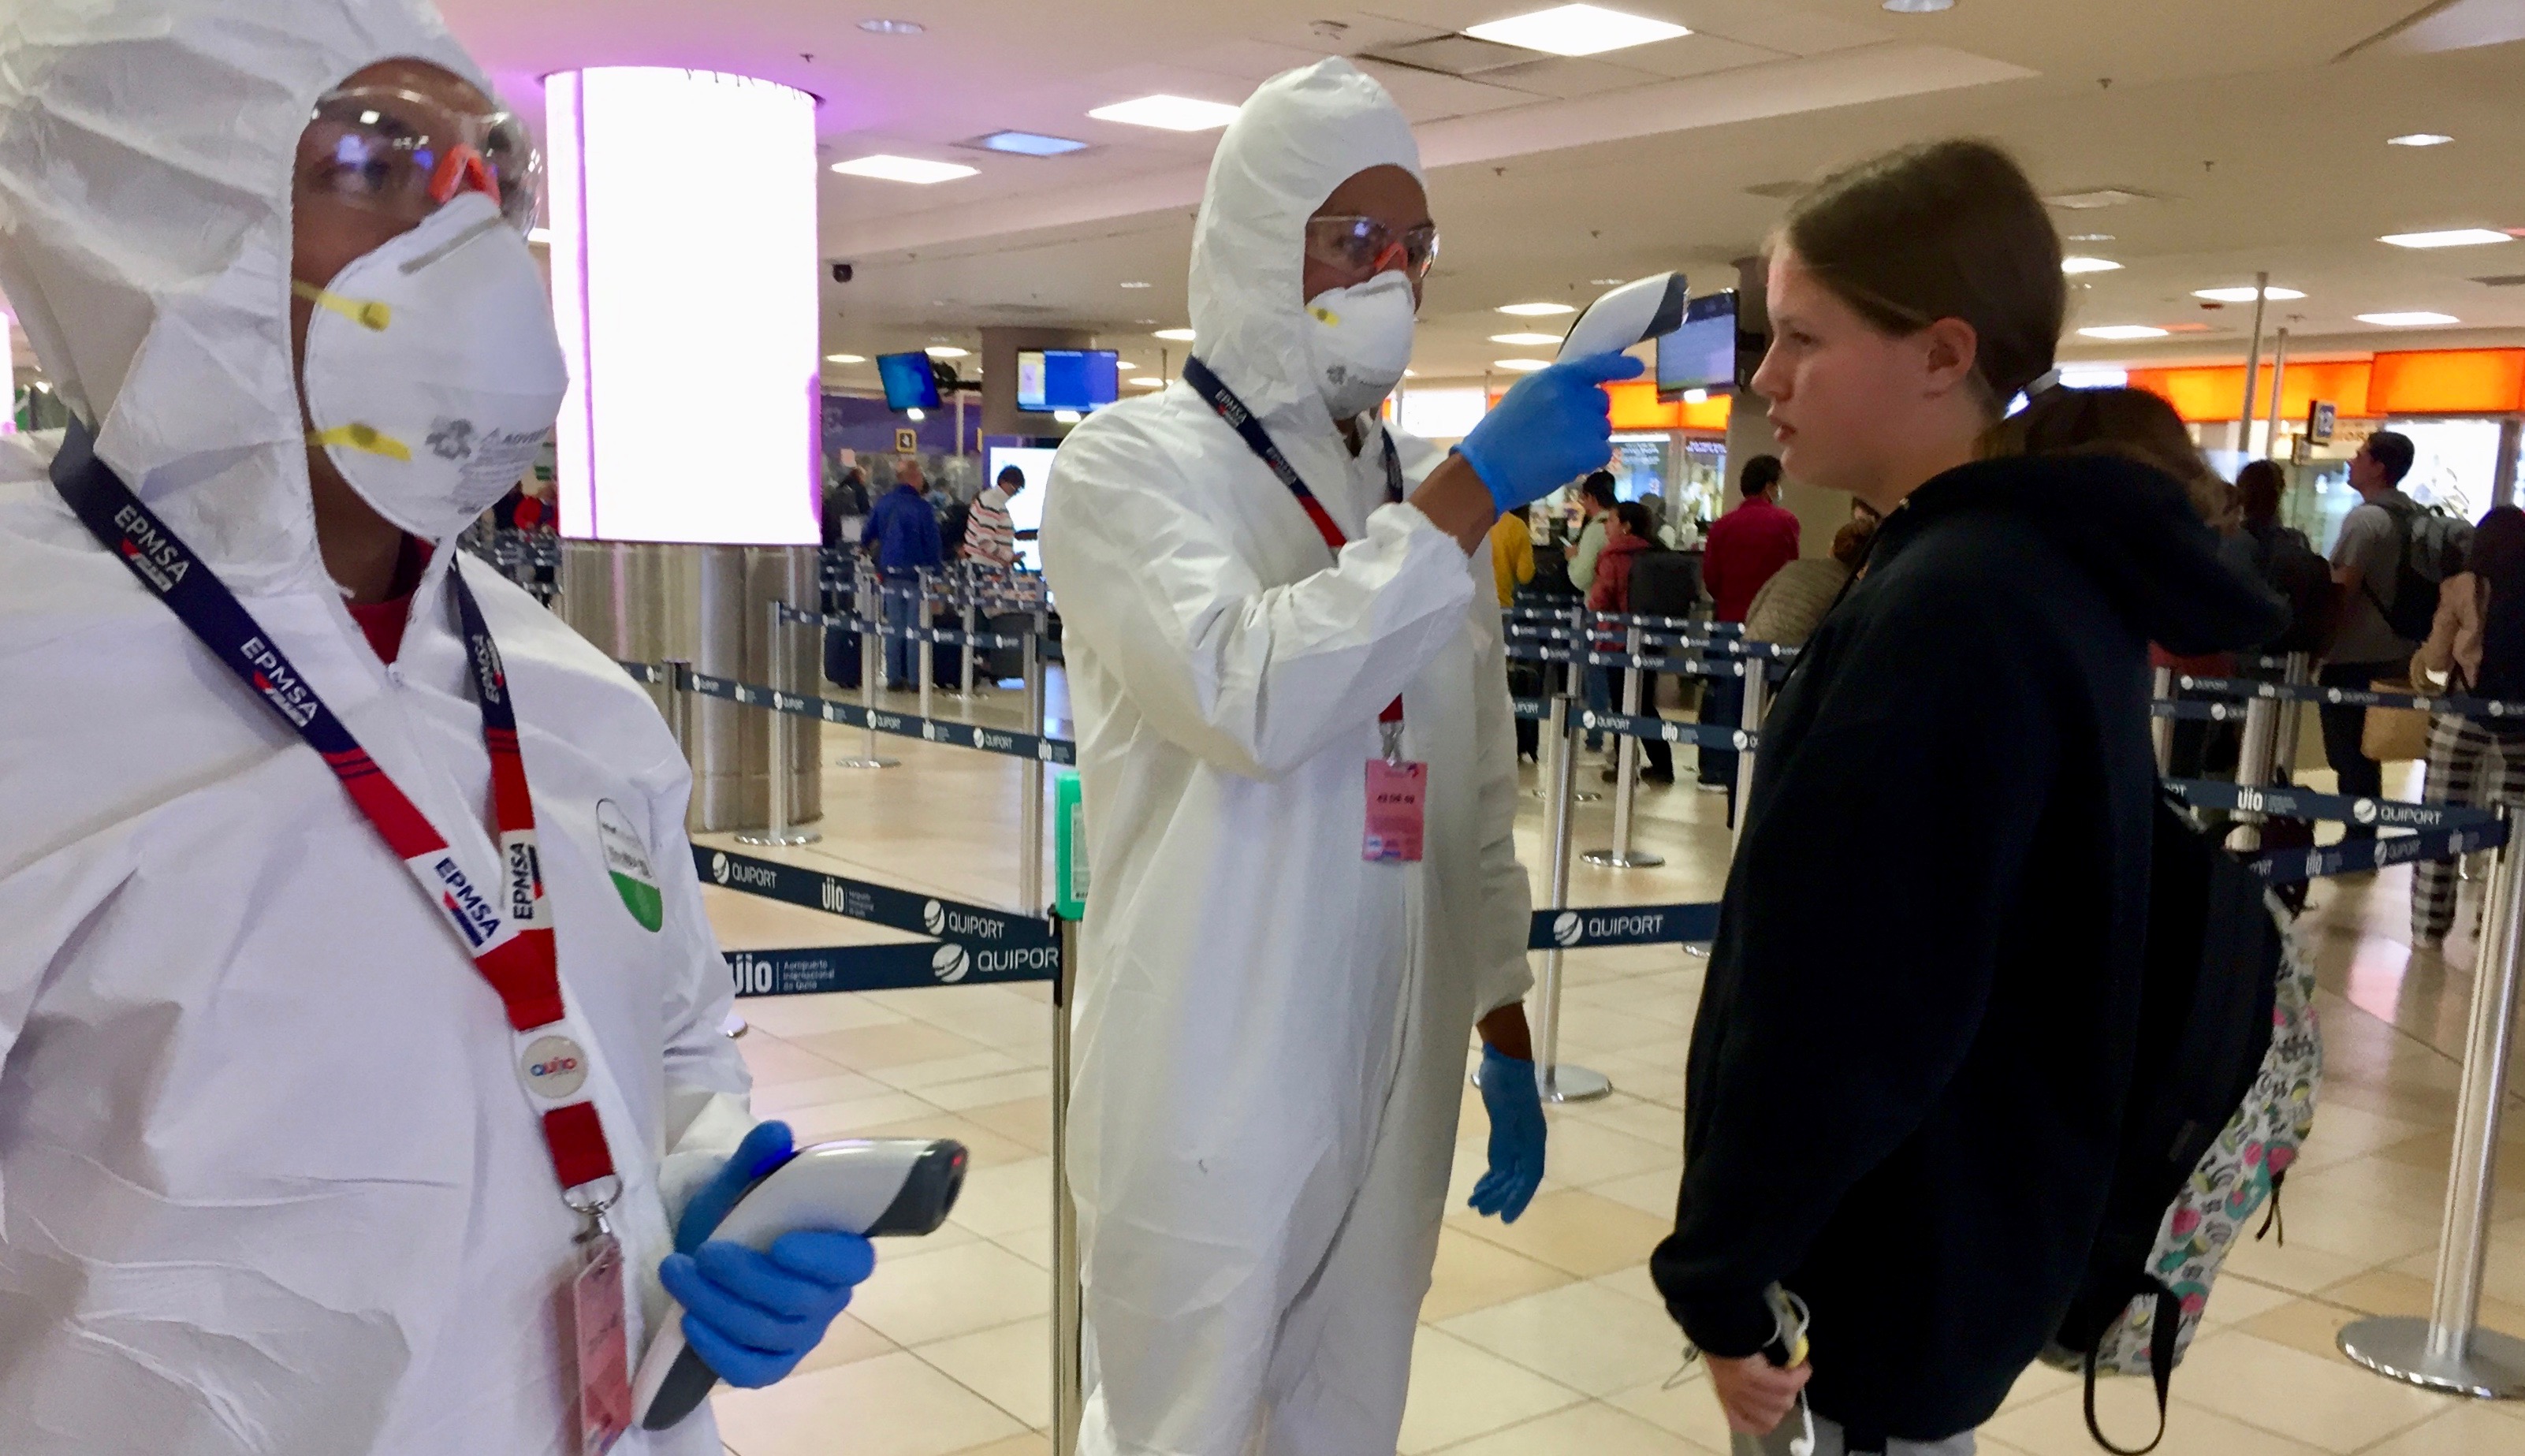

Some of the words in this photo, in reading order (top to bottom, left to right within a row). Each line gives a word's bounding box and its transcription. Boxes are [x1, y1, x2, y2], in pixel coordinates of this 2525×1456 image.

[114, 504, 190, 583] EPMSA
[239, 635, 318, 721] EPMSA
[2381, 804, 2443, 825] QUIPORT
[434, 856, 501, 939] EPMSA
[510, 843, 534, 920] EPMSA
[732, 861, 778, 889] QUIPORT
[948, 910, 1006, 940] QUIPORT
[1588, 914, 1664, 937] QUIPORT
